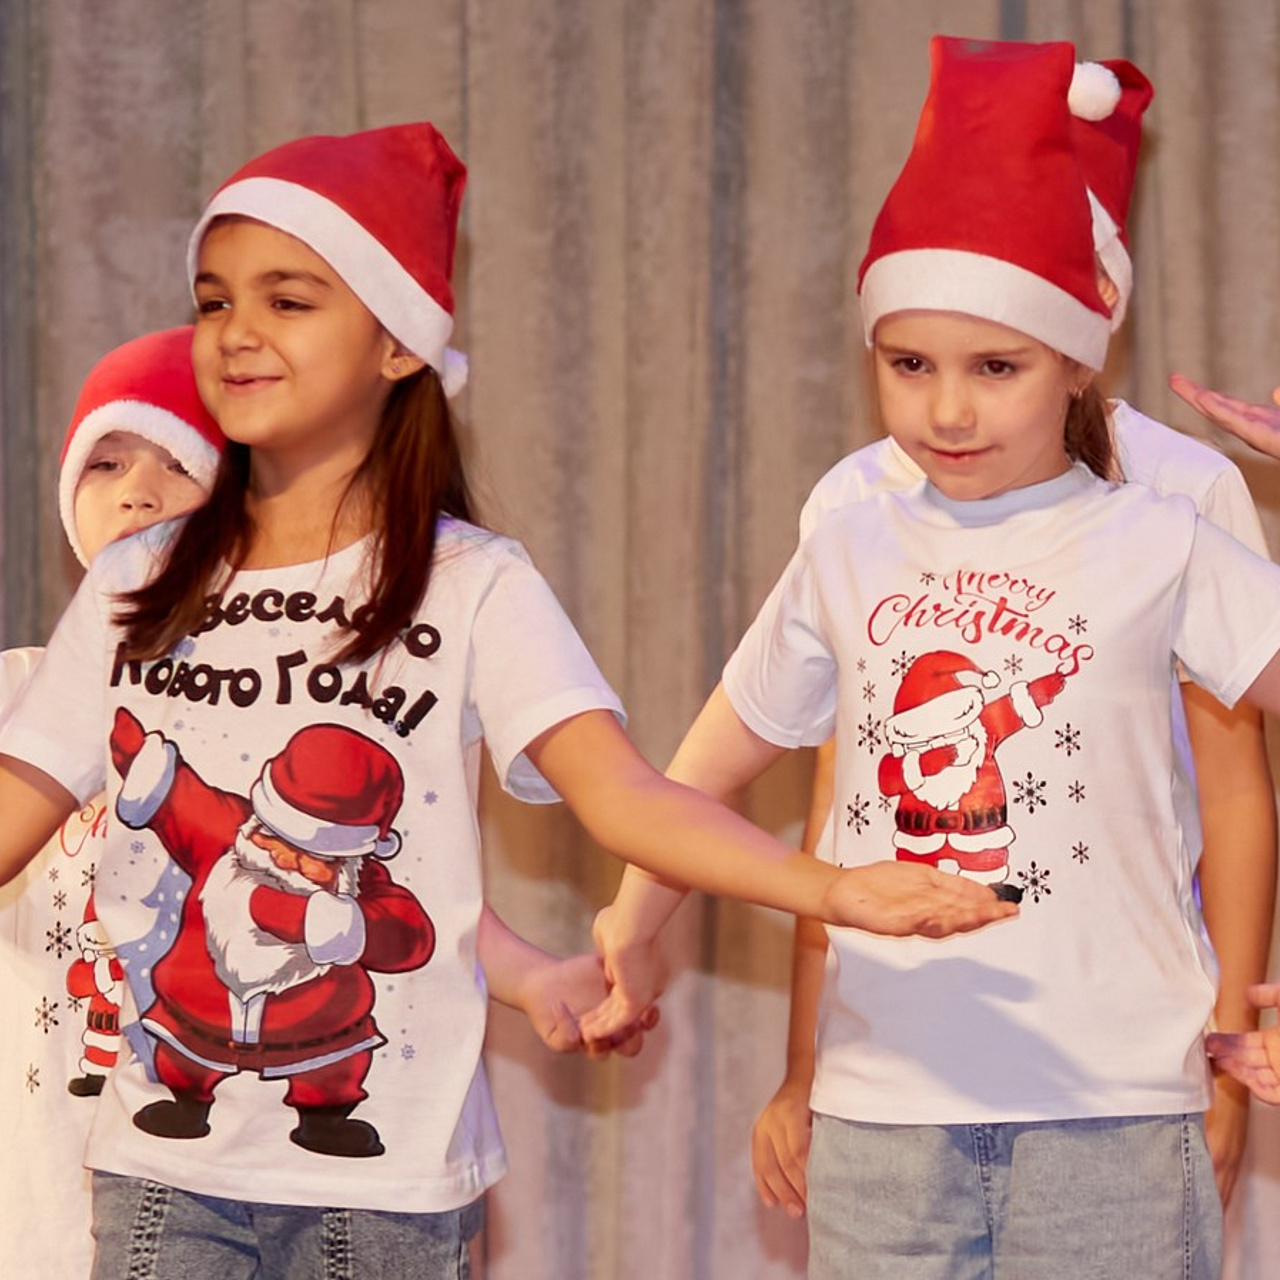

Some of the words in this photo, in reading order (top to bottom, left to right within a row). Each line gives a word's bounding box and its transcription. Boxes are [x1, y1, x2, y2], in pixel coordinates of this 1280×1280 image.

[943, 570, 1056, 612] Merry
[867, 593, 1094, 677] Christmas
[275, 649, 438, 737] Года!
